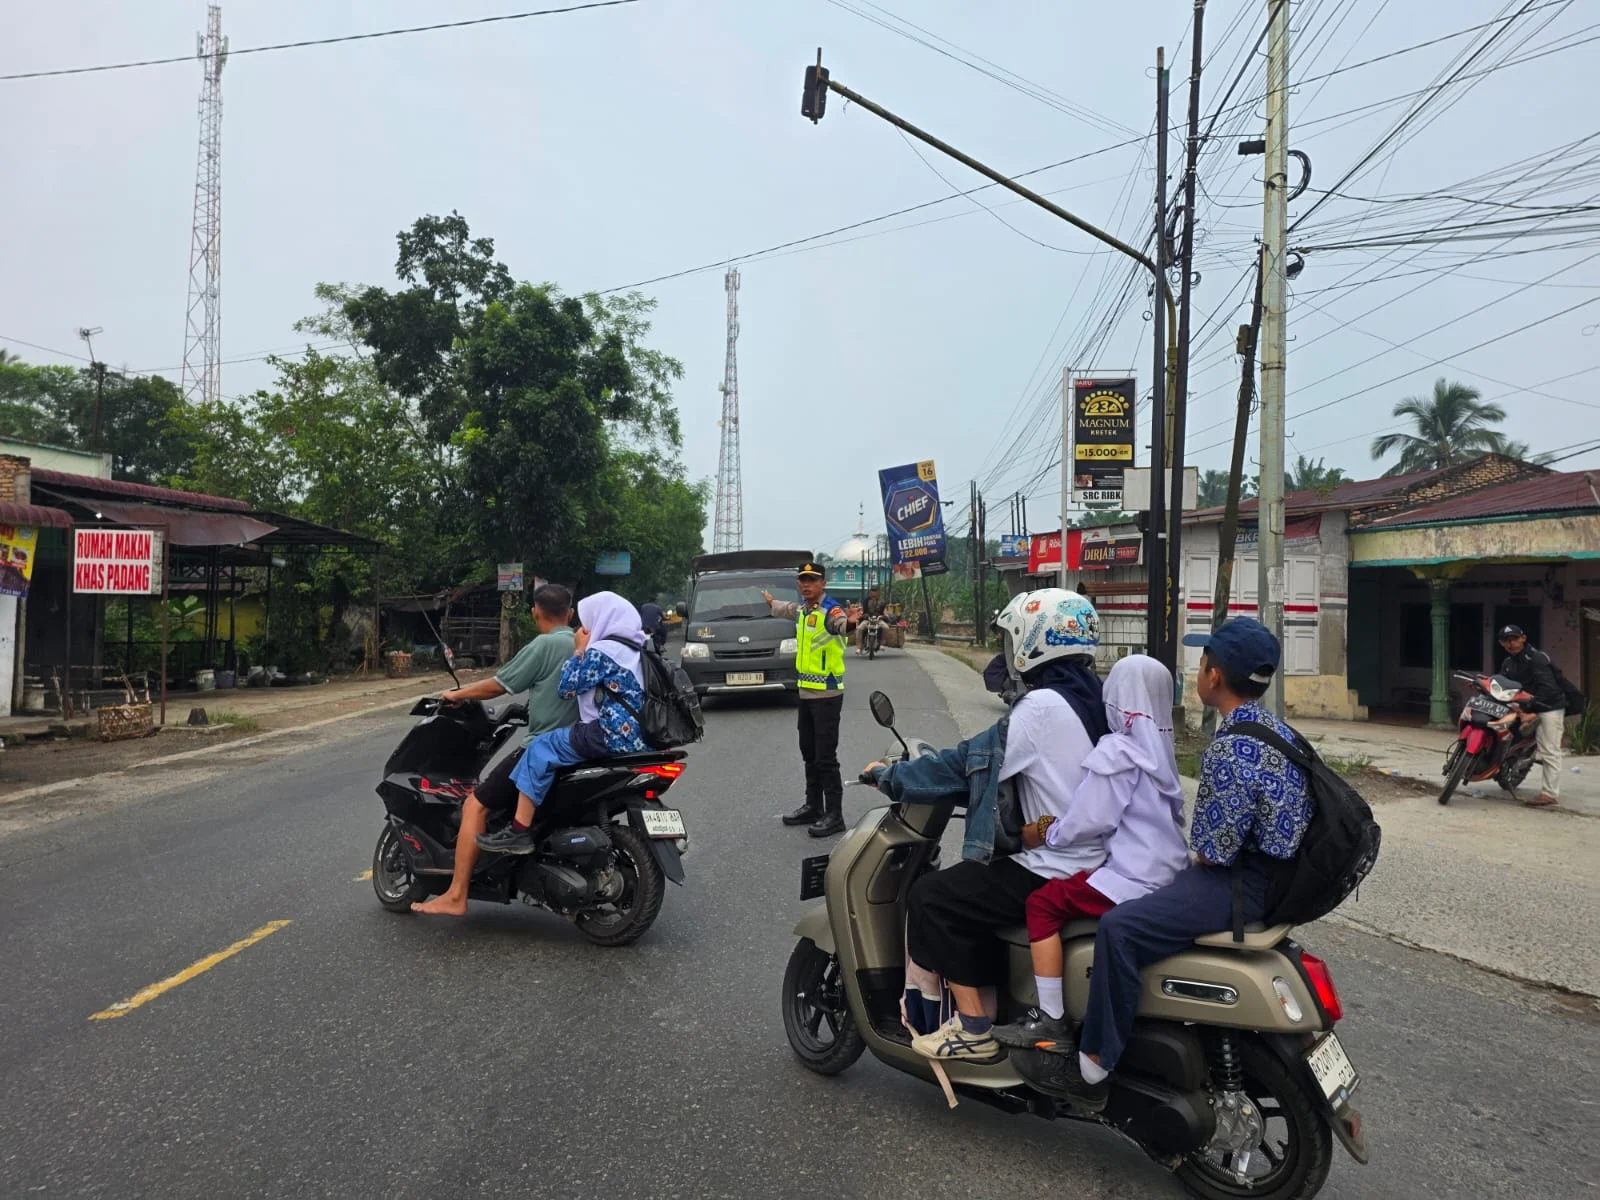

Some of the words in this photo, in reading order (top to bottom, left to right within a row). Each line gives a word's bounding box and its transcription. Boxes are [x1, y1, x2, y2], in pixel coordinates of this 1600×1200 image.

[1090, 400, 1119, 413] 234
[1079, 419, 1130, 428] MAGNUM
[922, 467, 933, 476] 16
[1083, 491, 1100, 500] SRC
[1101, 491, 1121, 500] RIBK
[897, 495, 928, 521] CHIEF
[77, 532, 113, 559] RUMAH
[116, 533, 150, 560] MAKAN
[898, 536, 924, 550] LEBIH
[76, 563, 105, 590] KHAS
[107, 564, 150, 591] PADANG
